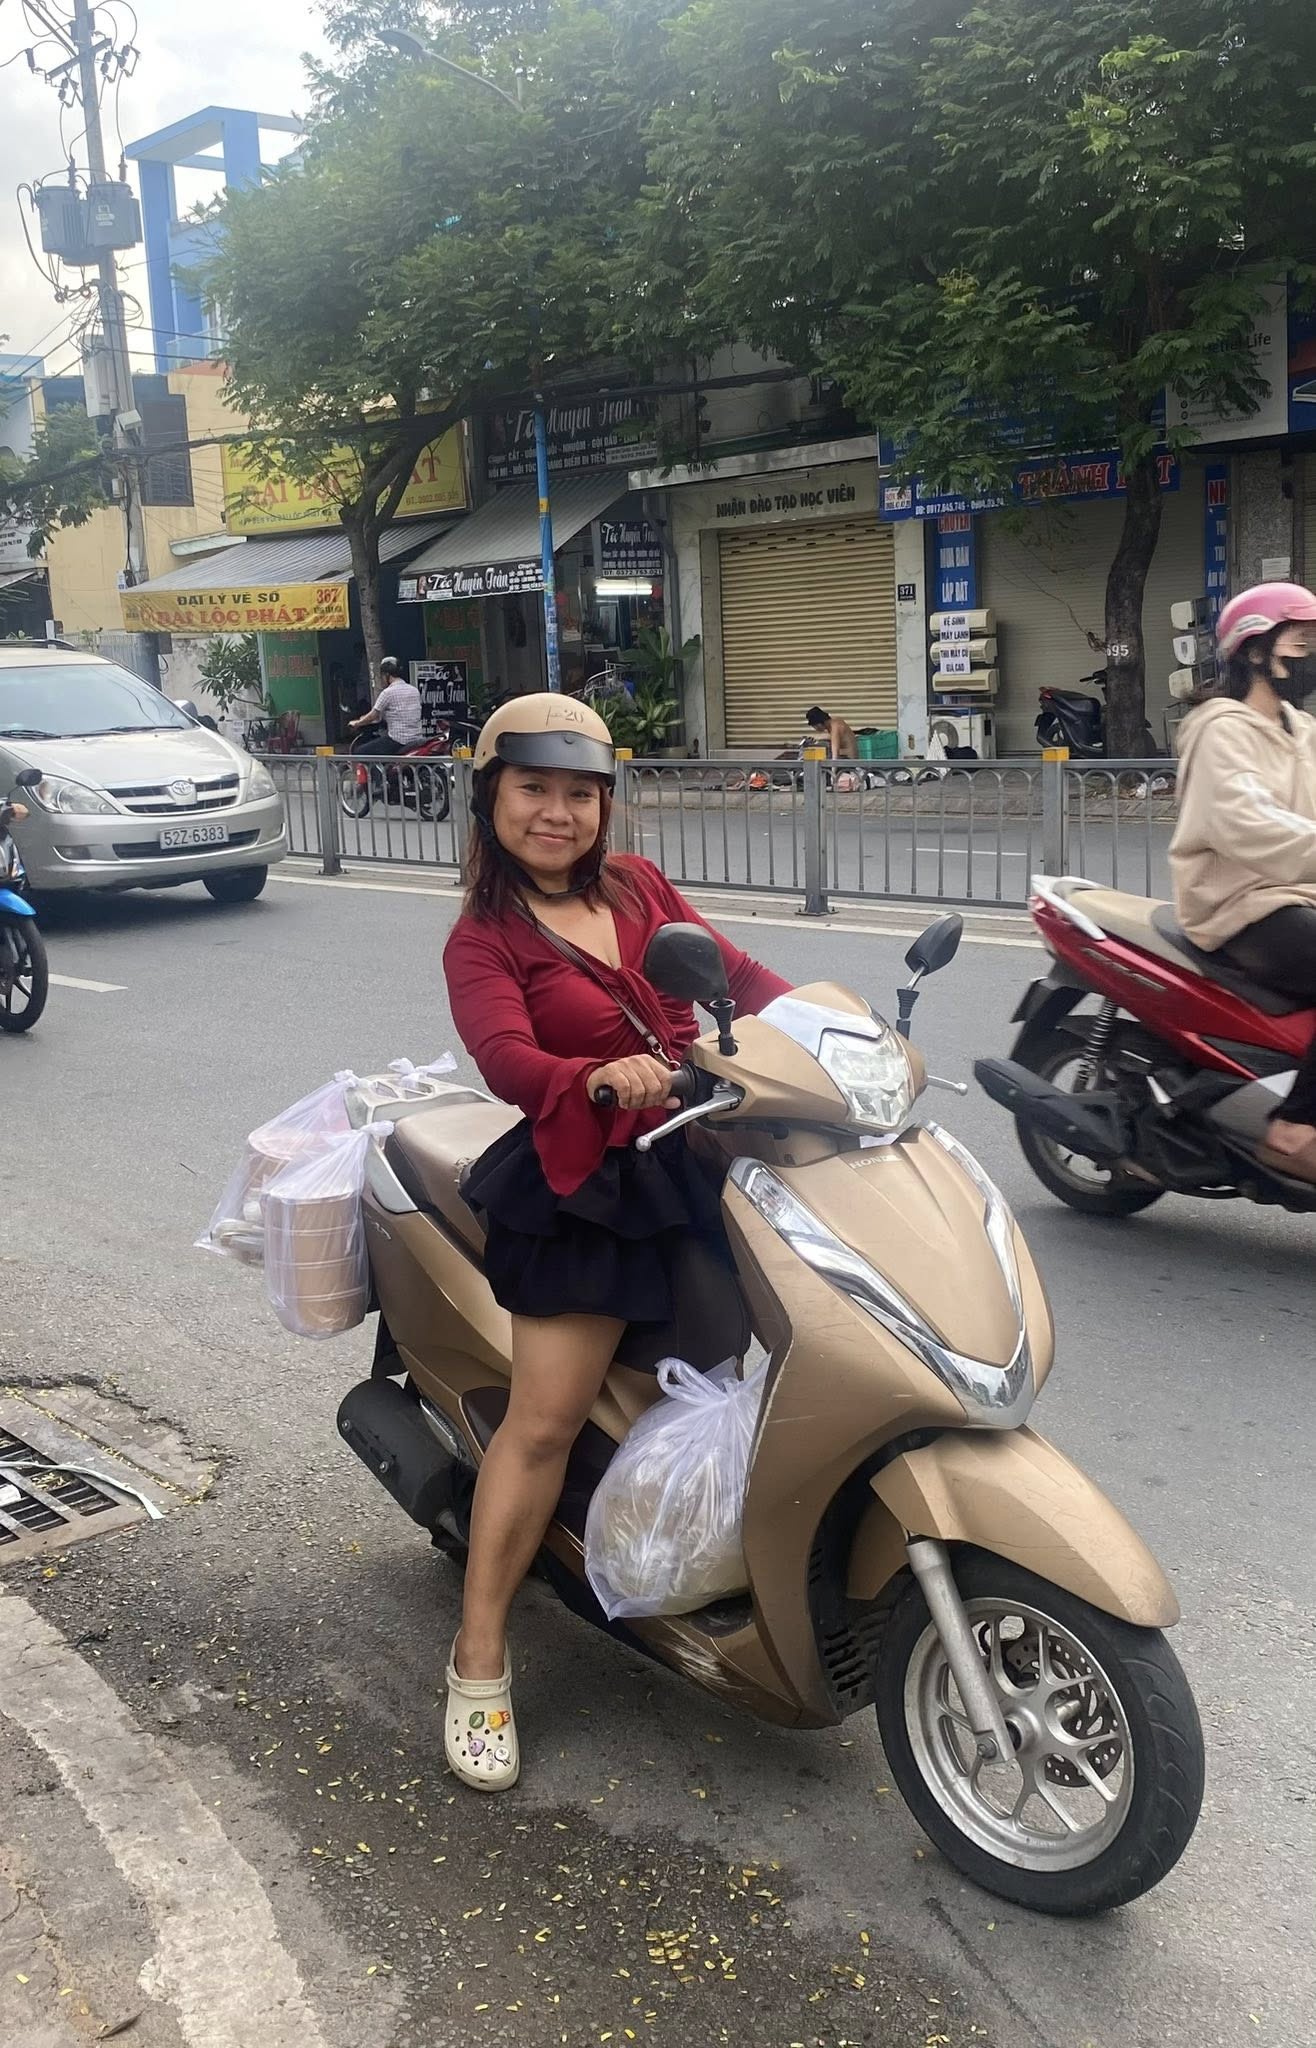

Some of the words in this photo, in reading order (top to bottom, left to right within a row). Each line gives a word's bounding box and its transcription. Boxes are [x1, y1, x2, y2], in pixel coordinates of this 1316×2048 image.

[1247, 333, 1272, 348] Life
[827, 483, 856, 504] VIÊN
[177, 594, 204, 608] ĐẠI
[208, 592, 226, 605] LÝ
[257, 587, 280, 603] SỐ
[245, 604, 309, 625] PHÁT
[163, 826, 225, 847] 52Z-6383
[849, 1155, 901, 1169] HOND
